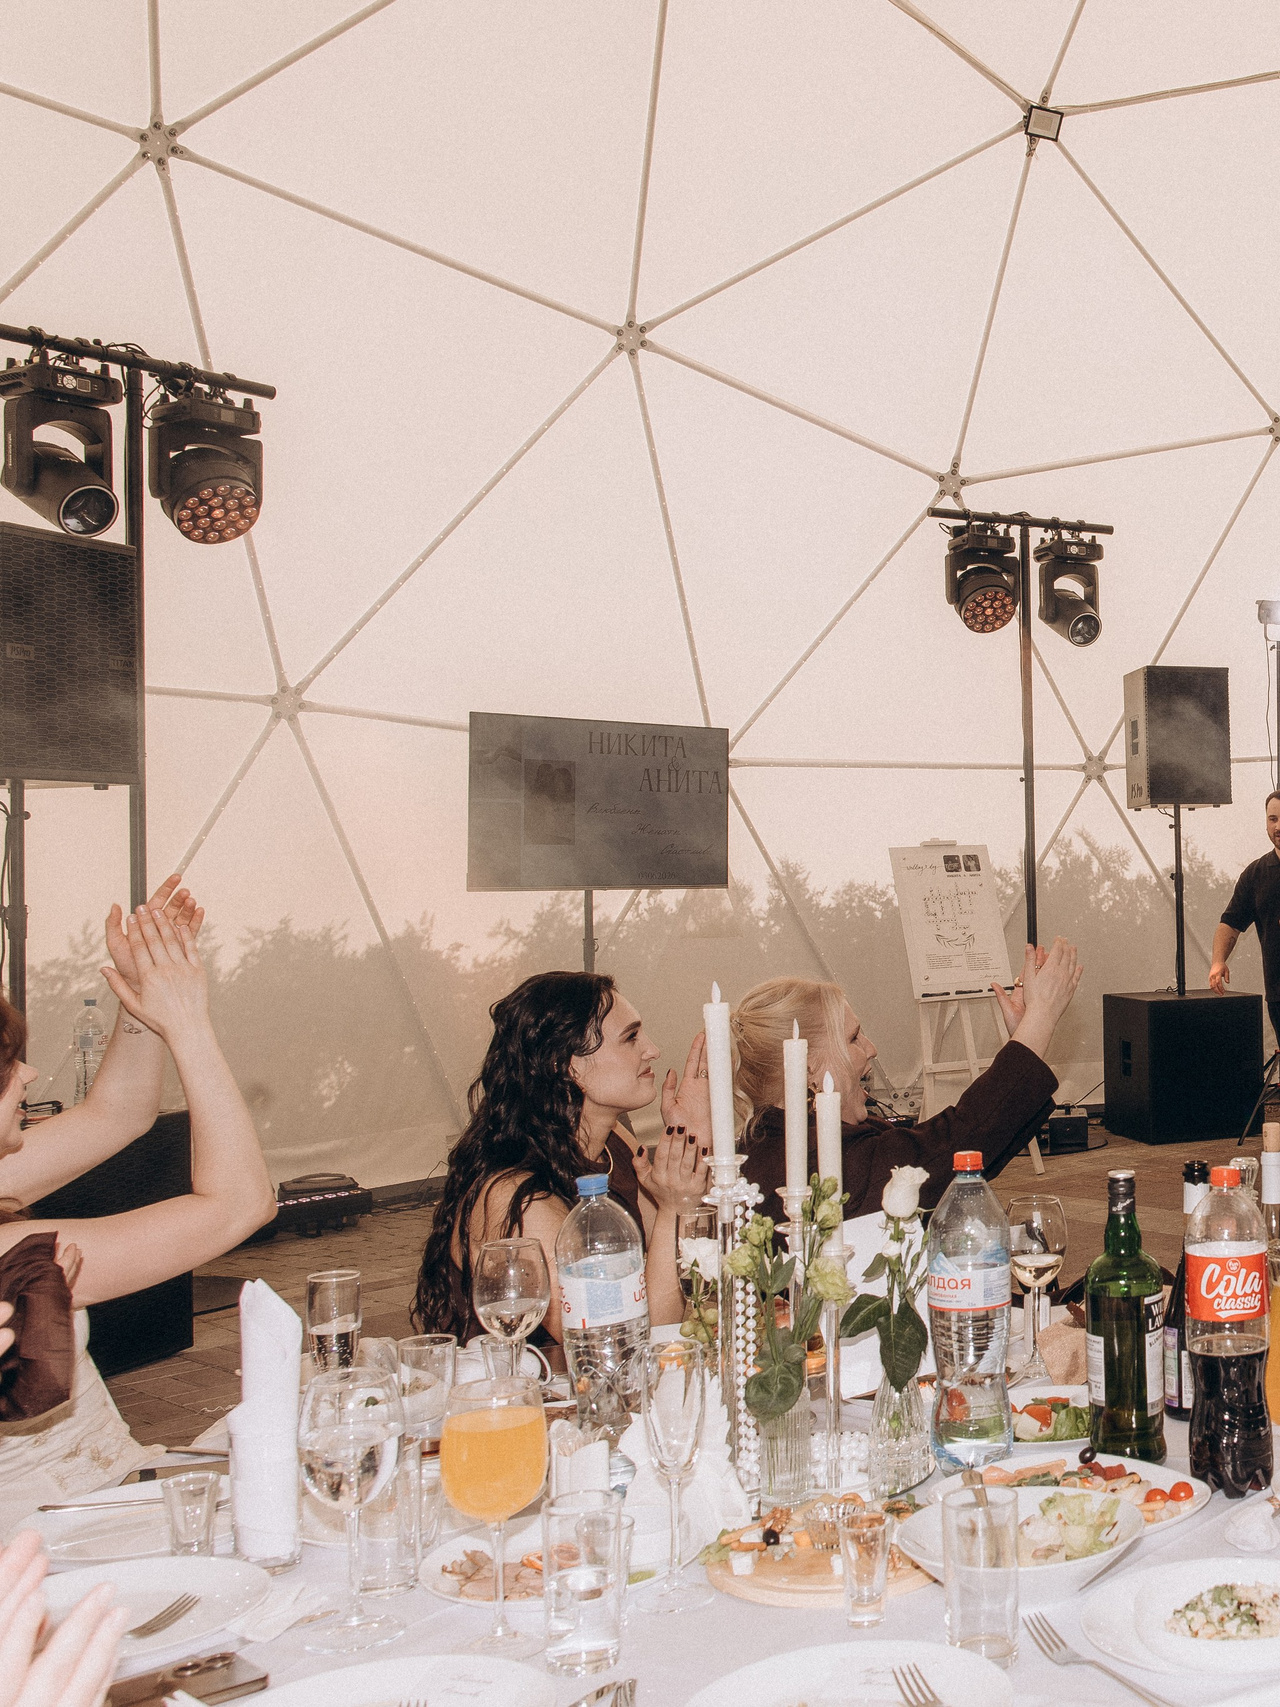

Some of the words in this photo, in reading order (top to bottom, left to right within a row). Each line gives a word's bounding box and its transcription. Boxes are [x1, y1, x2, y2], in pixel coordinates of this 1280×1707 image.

[588, 731, 688, 759] НИКИТА
[638, 768, 722, 795] АНИТА
[1201, 1263, 1262, 1299] Cola
[1213, 1293, 1261, 1311] classic
